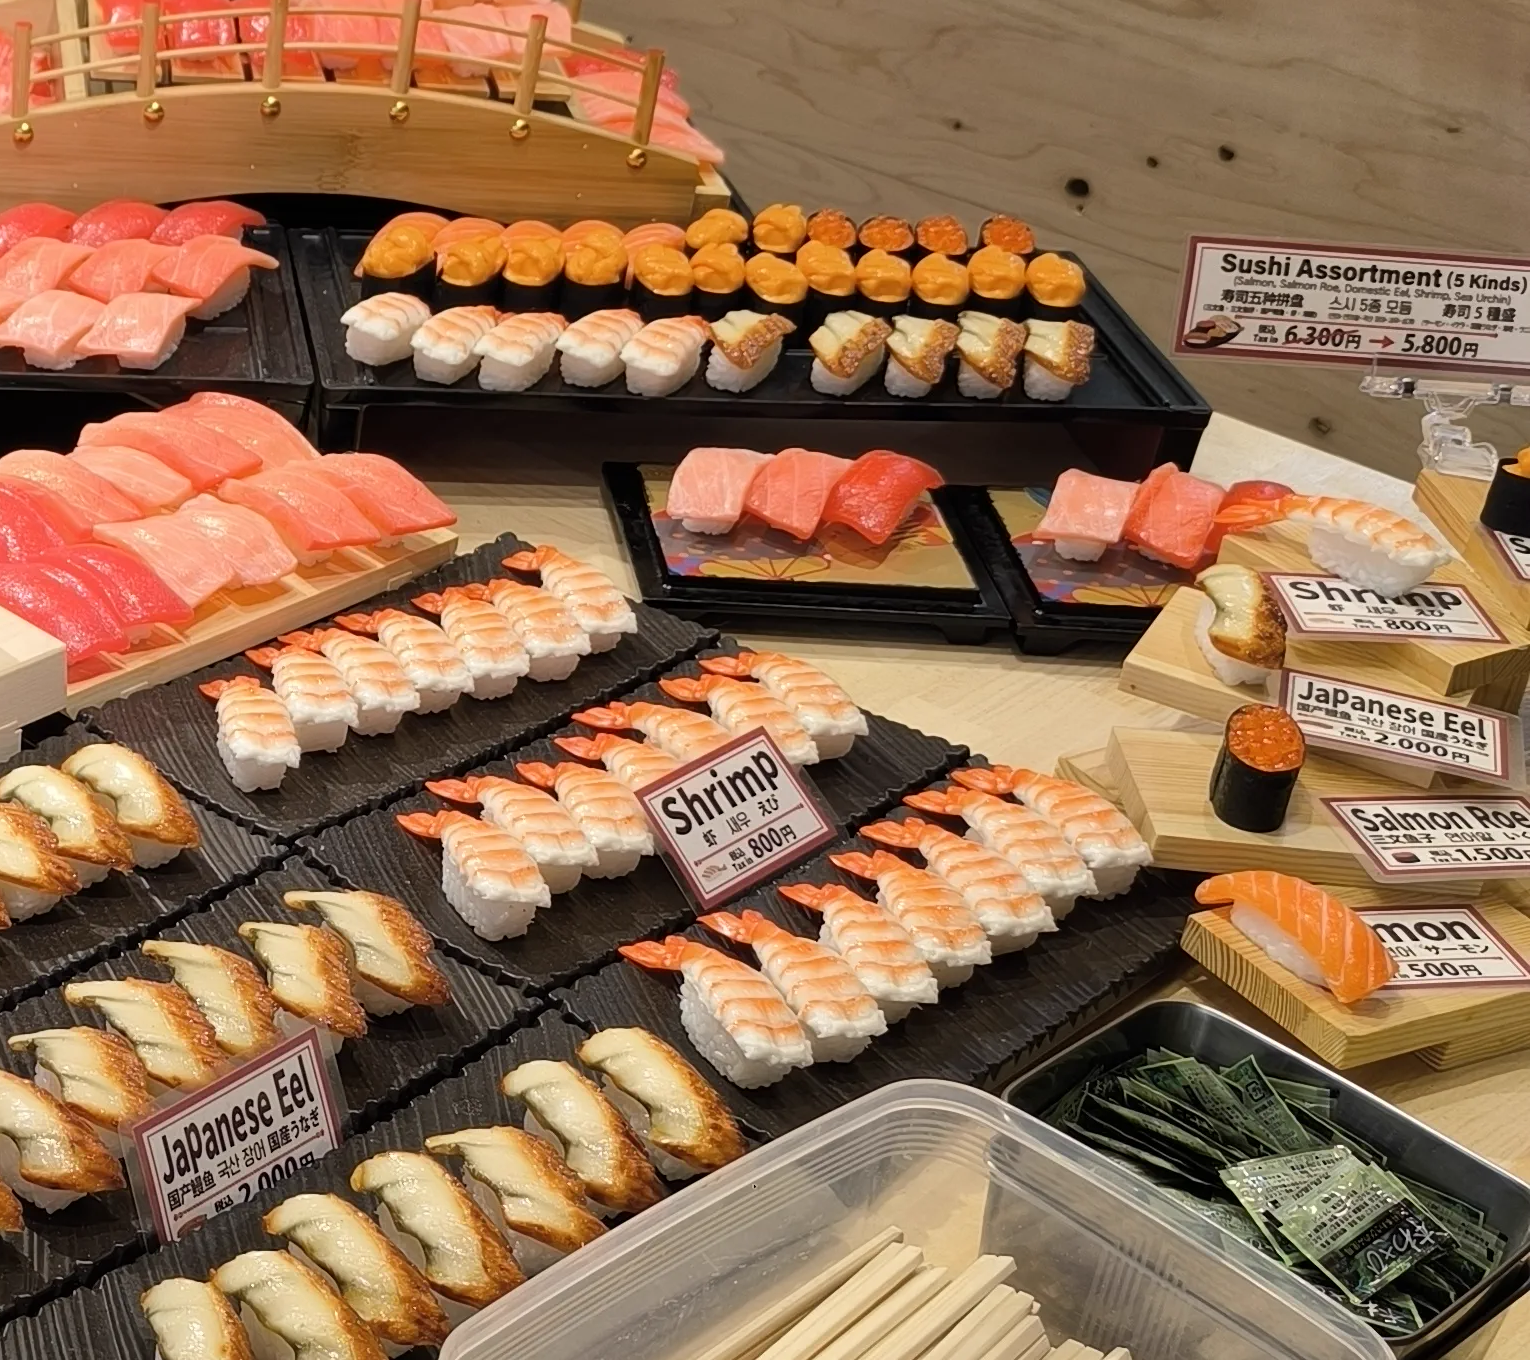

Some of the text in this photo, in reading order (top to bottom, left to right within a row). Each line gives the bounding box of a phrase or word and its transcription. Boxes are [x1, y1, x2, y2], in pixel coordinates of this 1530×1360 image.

[1220, 253, 1529, 295] Sushi Assortment (5 Kinds)
[1279, 279, 1318, 291] Salmon
[1475, 293, 1512, 306] Urchin)
[1328, 296, 1356, 311] 스시
[1359, 298, 1382, 314] 5종
[1400, 333, 1479, 358] 5,800円
[1383, 619, 1453, 633] 800円
[1297, 681, 1487, 740] Japanese Eel
[1373, 732, 1470, 763] 2,000円
[661, 750, 779, 836] Shrimp
[757, 793, 779, 817] えび
[725, 811, 752, 836] 새우
[1350, 805, 1530, 832] Salmon Roe
[702, 829, 719, 848] 虾
[747, 824, 797, 859] 800円
[731, 859, 747, 872] Tax
[1371, 920, 1481, 943] mon
[1423, 944, 1489, 955] サーモン
[1407, 962, 1483, 978] 500円
[162, 1054, 315, 1185] Japanese Eel
[266, 1106, 321, 1154] 国産うなぎ
[216, 1139, 267, 1180] 국산 장어
[167, 1169, 217, 1212] 国产鳗鱼
